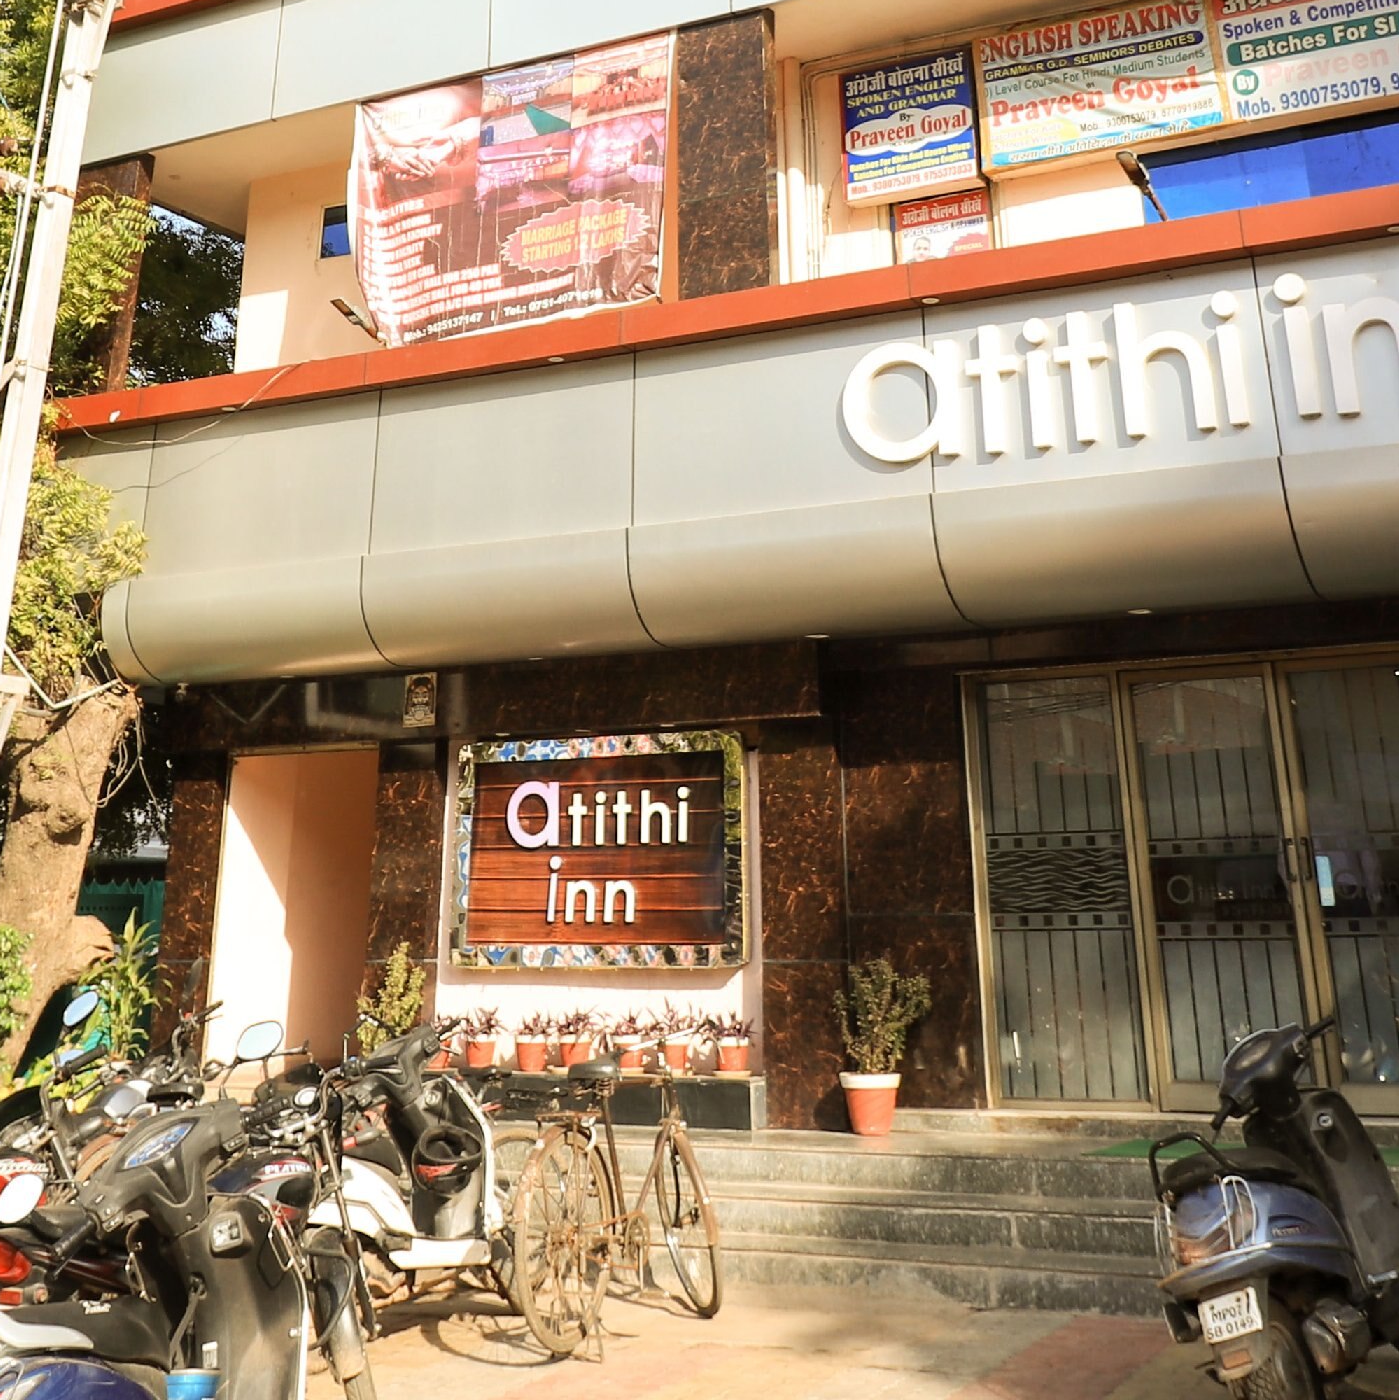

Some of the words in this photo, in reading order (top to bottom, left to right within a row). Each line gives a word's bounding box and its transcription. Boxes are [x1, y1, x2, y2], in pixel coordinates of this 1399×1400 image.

[980, 23, 1073, 64] ENGLISH
[1077, 0, 1200, 44] SPEAKING
[1222, 15, 1284, 42] Spoken
[1290, 9, 1302, 25] &
[1239, 28, 1328, 63] Batches
[1333, 21, 1368, 43] For
[1374, 15, 1398, 35] SI
[1074, 45, 1136, 66] SEMINORS
[1139, 33, 1196, 54] DEBATES
[1235, 74, 1256, 93] By
[1262, 47, 1389, 87] Praveen
[846, 70, 886, 97] अंग्रेजी
[887, 61, 930, 86] बोलना
[847, 88, 900, 109] SPOKEN
[904, 74, 965, 96] ENGLISH
[994, 80, 1021, 97] Level
[1024, 73, 1060, 91] Course
[1063, 70, 1081, 84] For
[1112, 59, 1155, 77] Medium
[1156, 47, 1206, 68] Students
[856, 103, 886, 119] AND
[888, 88, 956, 112] GRAMMAR
[990, 89, 1106, 127] Praveen
[1111, 65, 1201, 104] Goyal
[1236, 98, 1275, 120] Mob.
[849, 121, 916, 150] Praveen
[919, 108, 968, 136] Goyal
[521, 219, 576, 246] MARRIAGE
[579, 209, 627, 231] PACKAGE
[522, 237, 571, 263] STARTING
[842, 289, 1252, 465] atithi
[506, 780, 691, 849] atithi
[546, 856, 638, 924] inn
